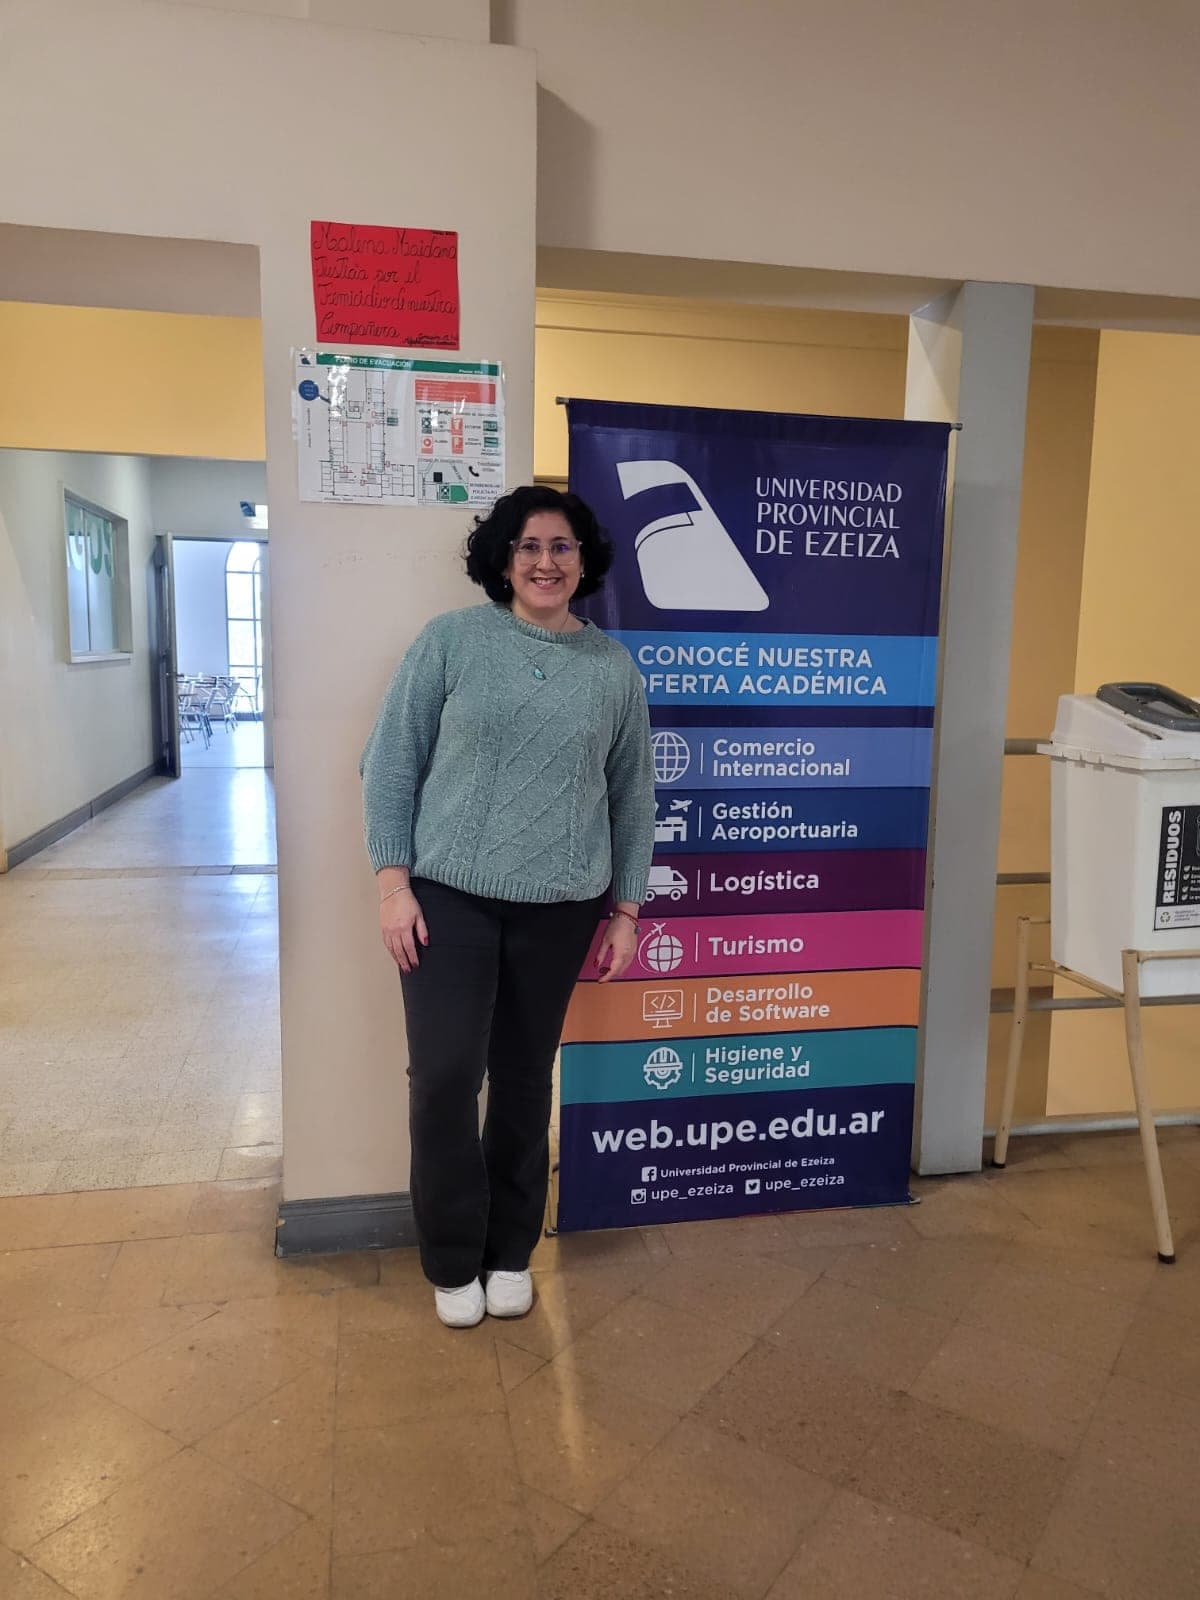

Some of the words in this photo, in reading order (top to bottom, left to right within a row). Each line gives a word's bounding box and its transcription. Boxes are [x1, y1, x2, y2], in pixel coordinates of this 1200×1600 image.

[756, 476, 903, 503] UNIVERSIDAD
[757, 502, 900, 529] PROVINCIAL
[756, 529, 793, 555] DE
[805, 531, 900, 558] EZEIZA
[637, 642, 750, 667] CONOCÉ
[758, 647, 873, 668] NUESTRA
[738, 670, 887, 695] ACADÉMICA
[712, 738, 816, 757] Comercio
[712, 759, 851, 777] Internacional
[712, 801, 794, 820] Gestión
[711, 821, 858, 842] Aeroportuaria
[1162, 810, 1182, 904] RESIDUOS
[710, 870, 820, 895] Logística
[708, 935, 804, 956] Turismo
[706, 983, 813, 1004] Desarrollo
[706, 1008, 731, 1024] de
[739, 1002, 831, 1023] Software
[705, 1046, 785, 1066] Higiene
[790, 1045, 803, 1061] y
[705, 1060, 811, 1085] Seguridad
[592, 1108, 885, 1154] web.upe.edu.ar
[660, 1165, 726, 1178] Universidad
[729, 1160, 782, 1173] Provincial
[784, 1158, 798, 1168] de
[801, 1157, 835, 1167] Ezeiza
[651, 1183, 734, 1201] upe_ezeiza
[765, 1174, 845, 1191] upe_ezeiza
